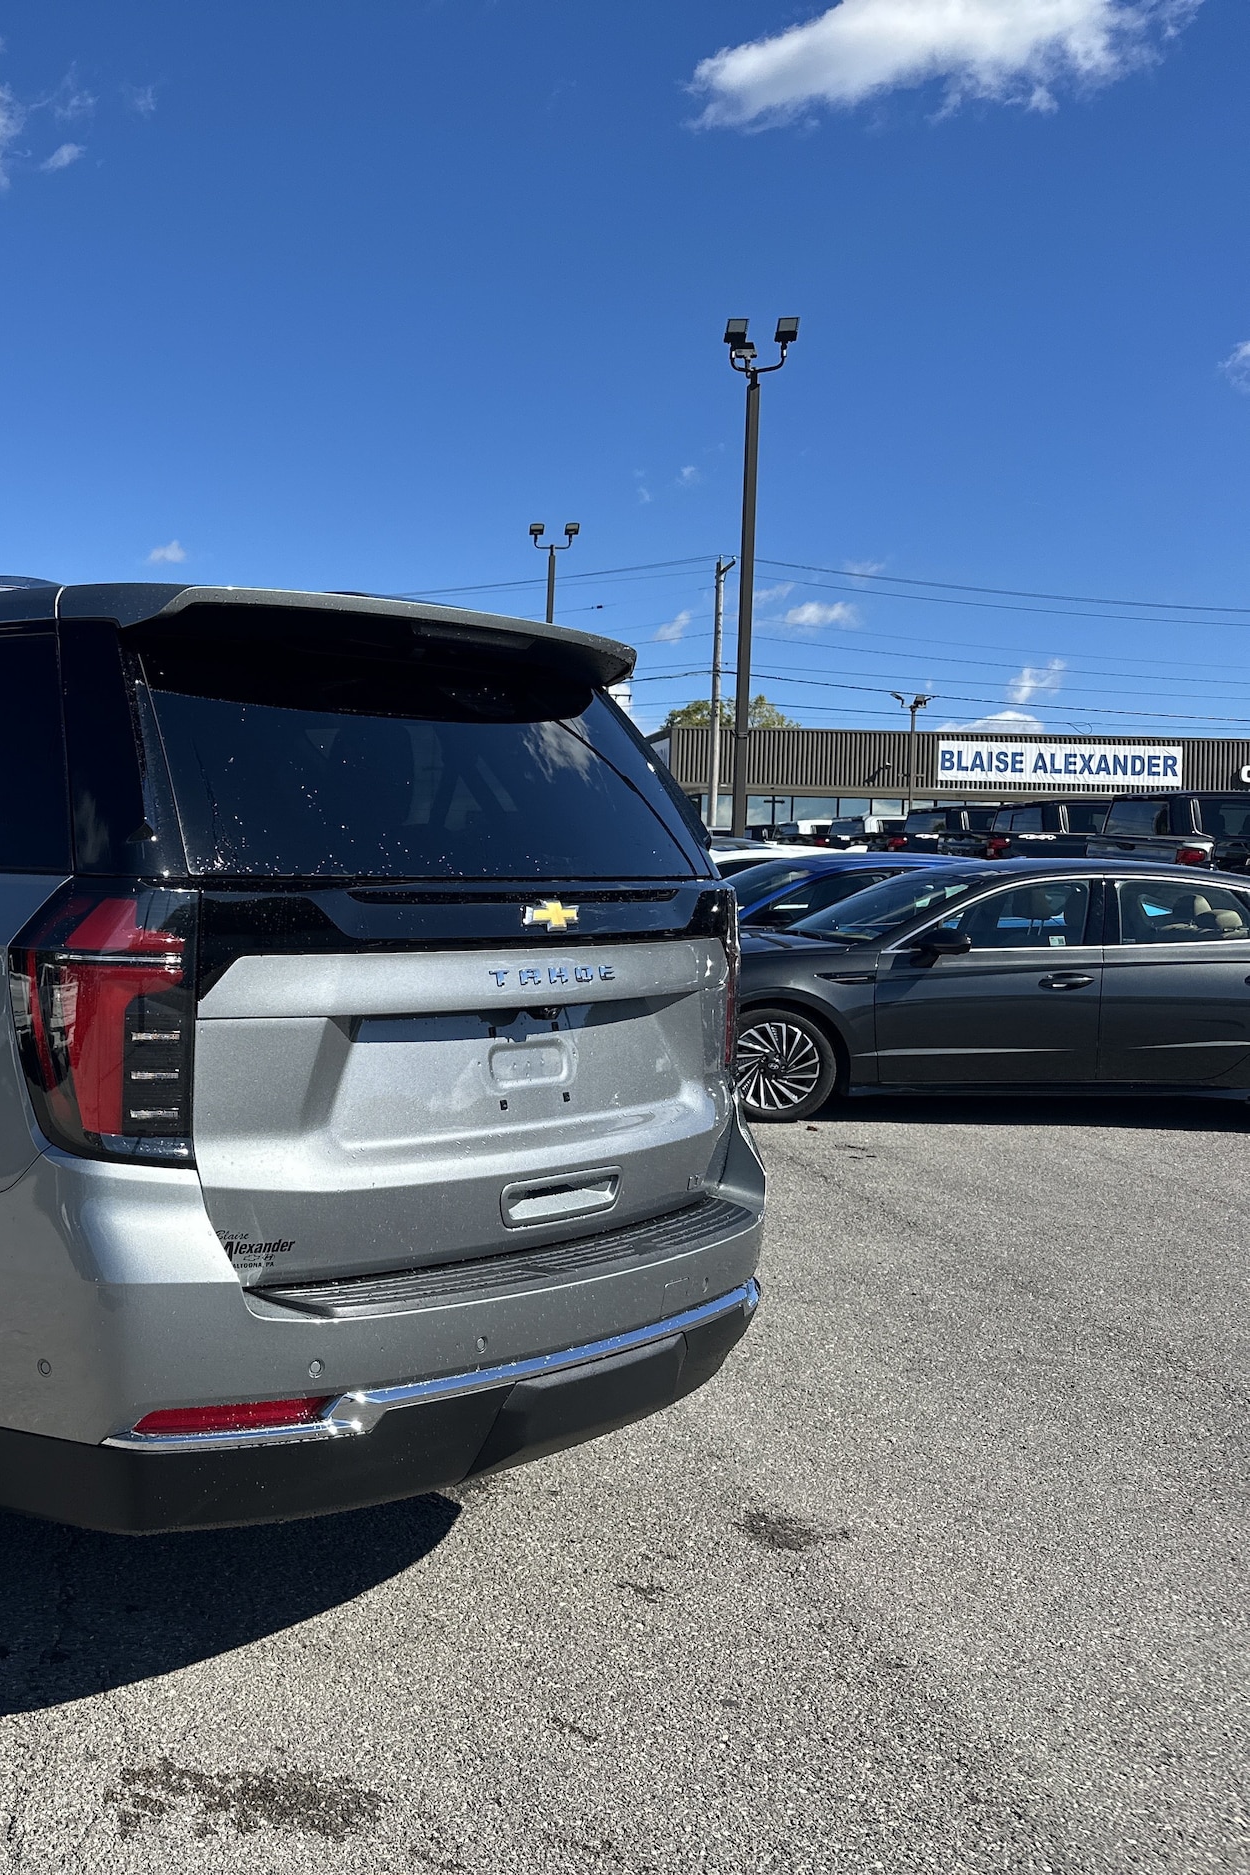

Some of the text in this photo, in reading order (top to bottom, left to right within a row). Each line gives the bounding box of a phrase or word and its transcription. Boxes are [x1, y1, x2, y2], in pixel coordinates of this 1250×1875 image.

[940, 750, 1179, 777] BLAISE ALEXANDER
[489, 964, 616, 987] TAHOE
[215, 1230, 250, 1240] Blaise
[223, 1239, 296, 1262] Alexander
